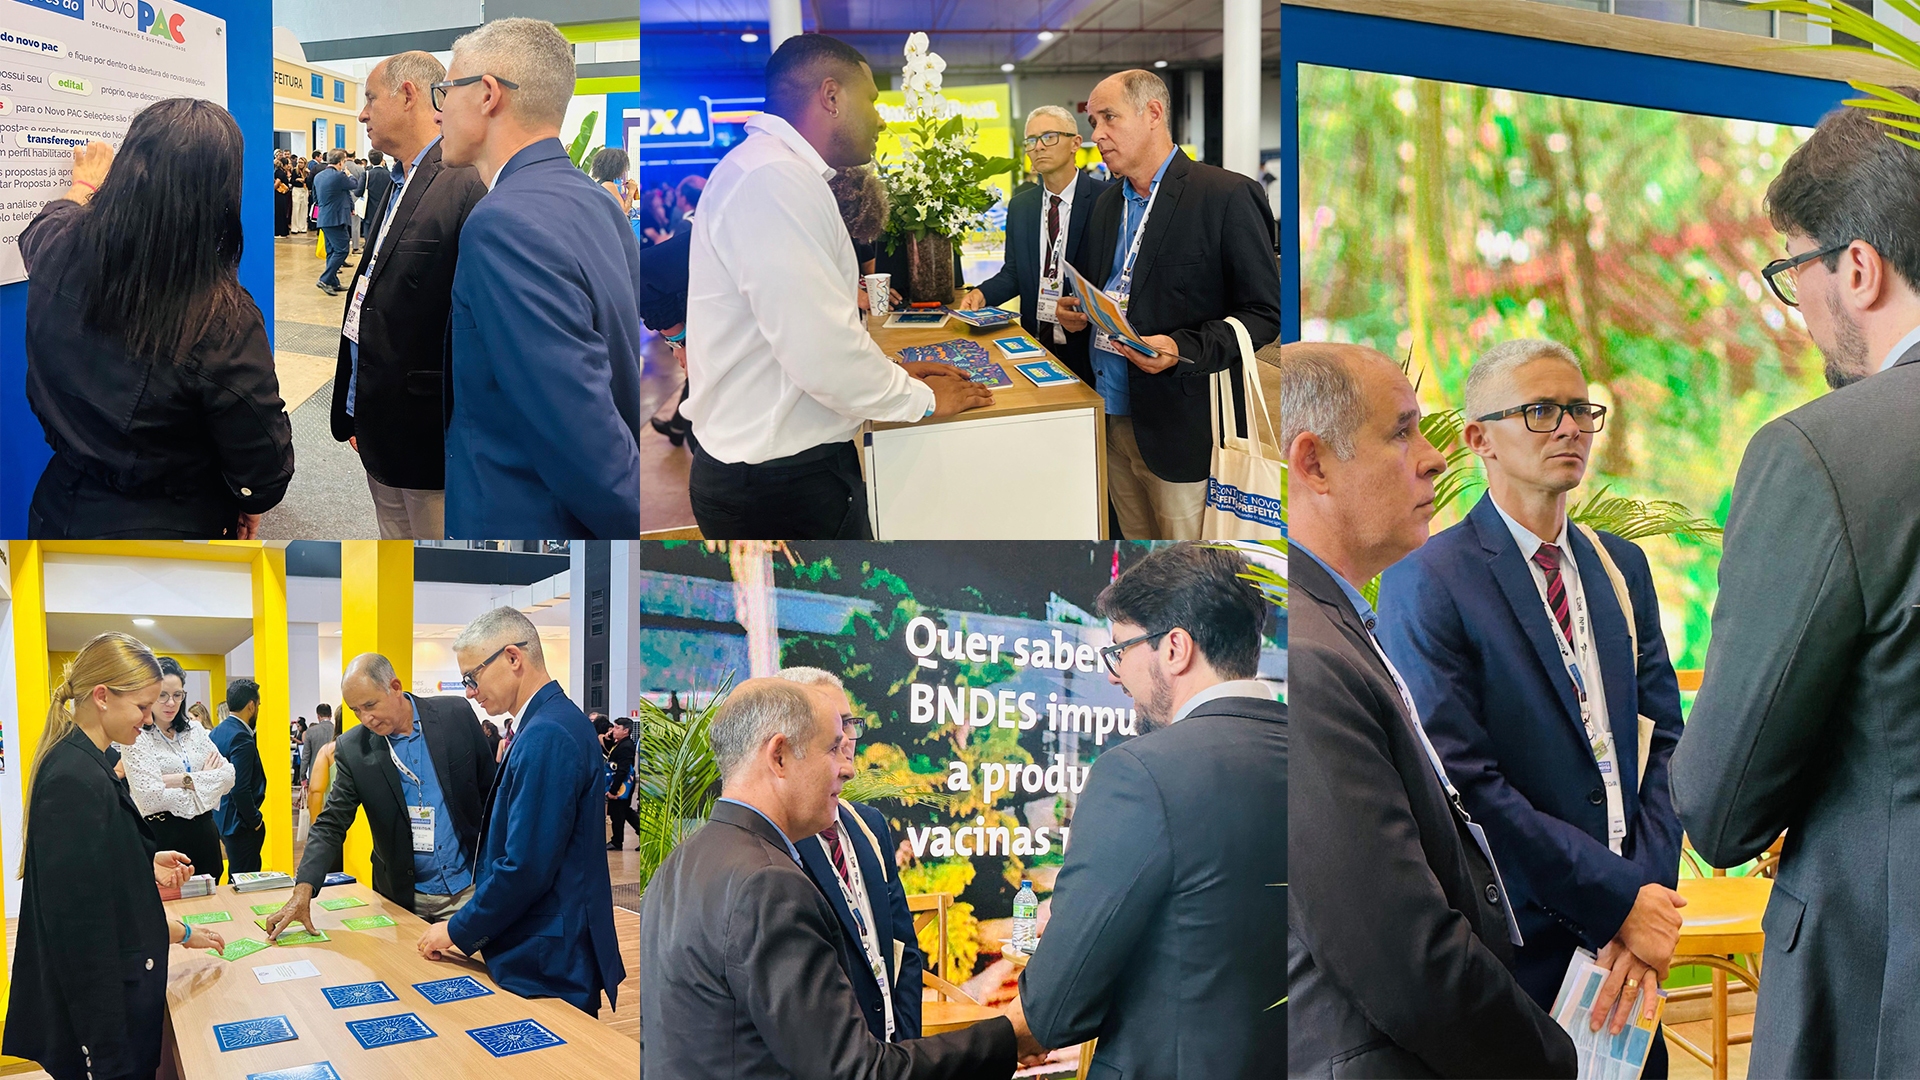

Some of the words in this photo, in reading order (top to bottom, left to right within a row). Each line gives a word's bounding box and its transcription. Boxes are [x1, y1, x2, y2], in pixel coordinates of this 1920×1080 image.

[137, 0, 186, 44] PAC
[0, 31, 14, 43] do
[16, 36, 40, 49] novo
[41, 42, 59, 52] pac
[91, 20, 140, 39] DESENVOLVIMENTO
[145, 36, 187, 53] SUSTENTABILIDADE
[75, 50, 93, 63] fique
[93, 56, 106, 65] por
[106, 58, 128, 70] dentro
[128, 62, 137, 72] da
[137, 65, 161, 78] abertura
[161, 70, 170, 79] de
[170, 73, 185, 83] novas
[26, 74, 43, 84] seu
[58, 79, 84, 91] edital
[101, 86, 126, 99] próprio,
[127, 90, 139, 101] que
[16, 103, 35, 114] para
[44, 106, 66, 117] Novo
[67, 108, 82, 118] PAC
[83, 109, 115, 124] Seleções
[115, 113, 128, 123] são
[102, 130, 111, 139] do
[8, 148, 31, 158] perfil
[32, 148, 72, 159] habilitado
[5, 168, 48, 178] propostas
[49, 167, 57, 178] já
[14, 180, 52, 189] Proposta
[59, 179, 72, 187] Pro
[6, 199, 38, 210] análise
[1250, 495, 1281, 511] NOVO
[905, 616, 1004, 669] Quer
[909, 683, 1037, 730] BNDES
[947, 760, 972, 792] a
[906, 815, 1051, 857] vacinas
